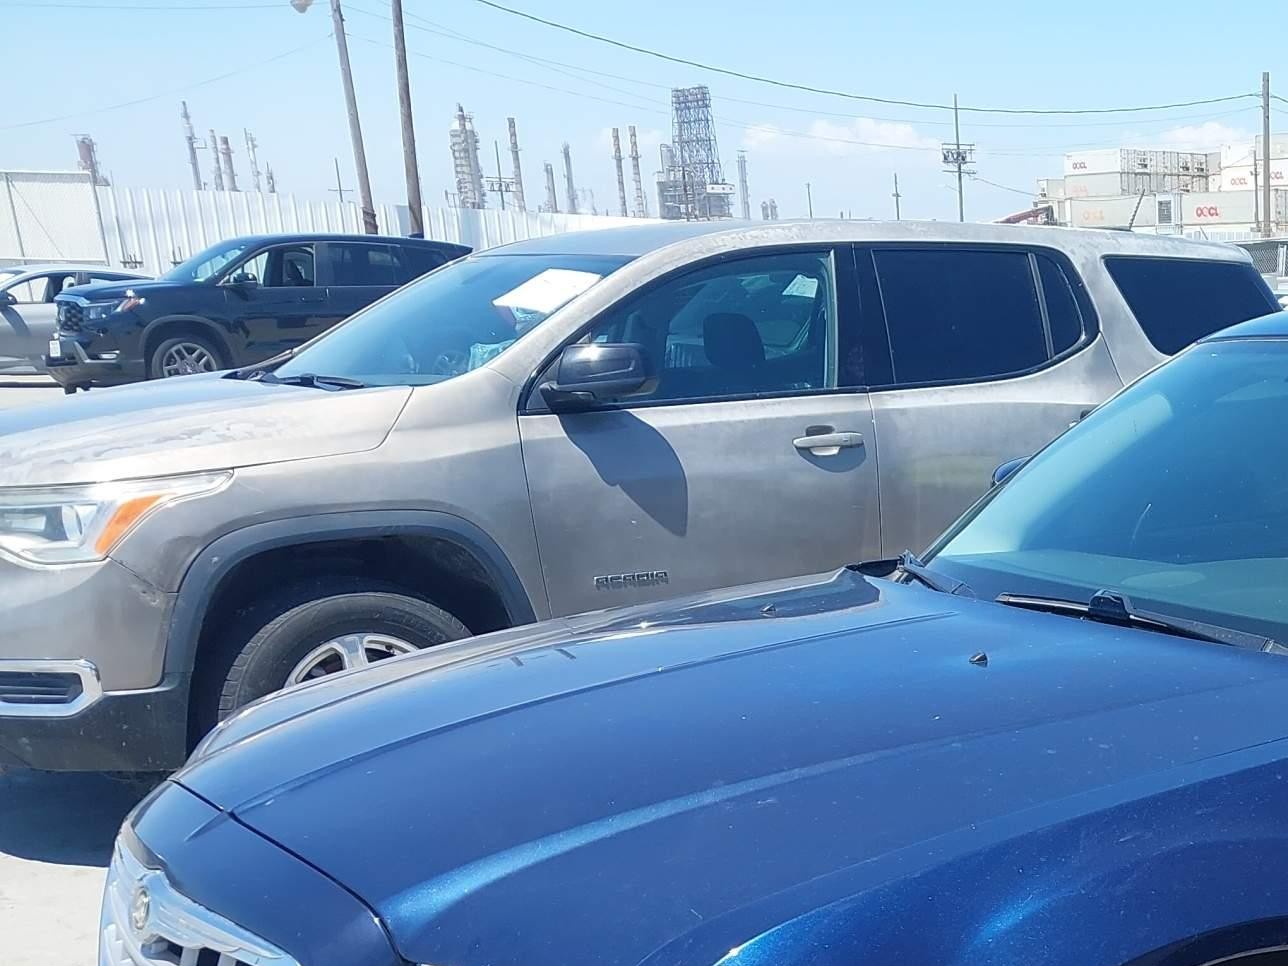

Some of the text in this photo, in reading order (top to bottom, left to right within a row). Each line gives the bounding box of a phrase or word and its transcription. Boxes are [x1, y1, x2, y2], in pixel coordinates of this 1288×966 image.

[1072, 162, 1088, 170] OOCL
[1230, 177, 1248, 186] OOCL
[1195, 206, 1219, 218] OOCL
[593, 570, 669, 587] ACADIA
